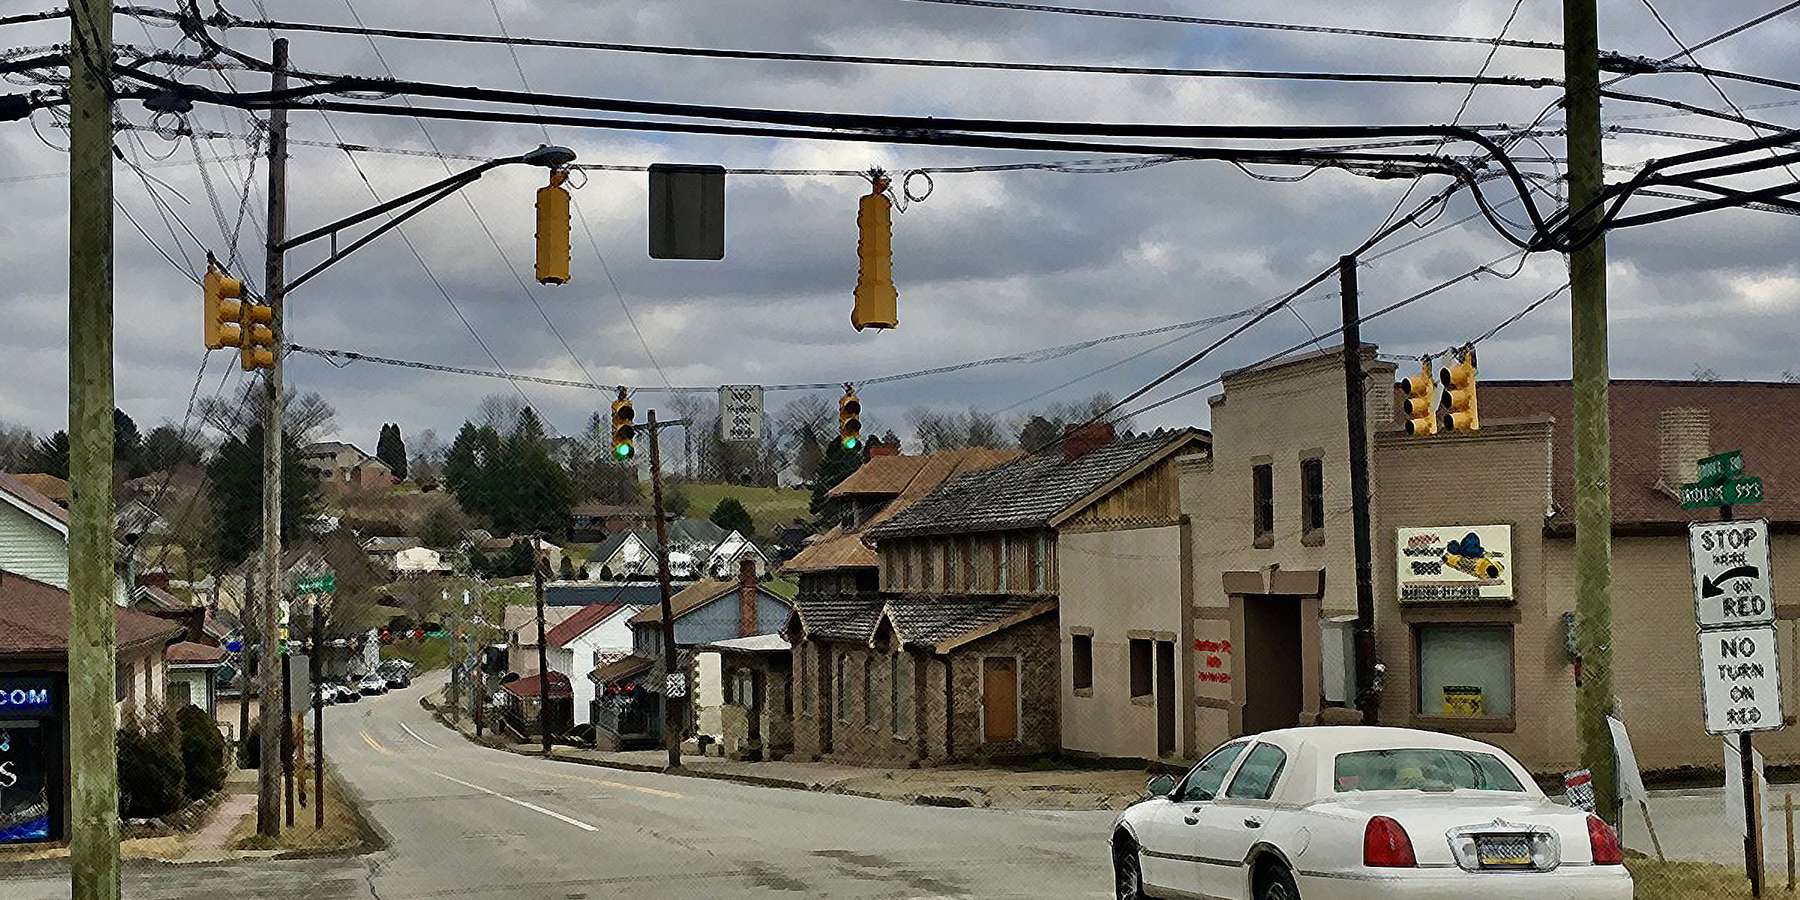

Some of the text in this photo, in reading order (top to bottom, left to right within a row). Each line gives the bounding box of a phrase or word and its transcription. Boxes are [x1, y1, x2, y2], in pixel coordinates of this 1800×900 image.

[1700, 527, 1758, 551] STOP
[1722, 595, 1766, 617] RED
[1720, 636, 1756, 658] NO
[1718, 662, 1765, 682] TURN
[1729, 685, 1755, 703] ON
[1725, 706, 1761, 726] RED
